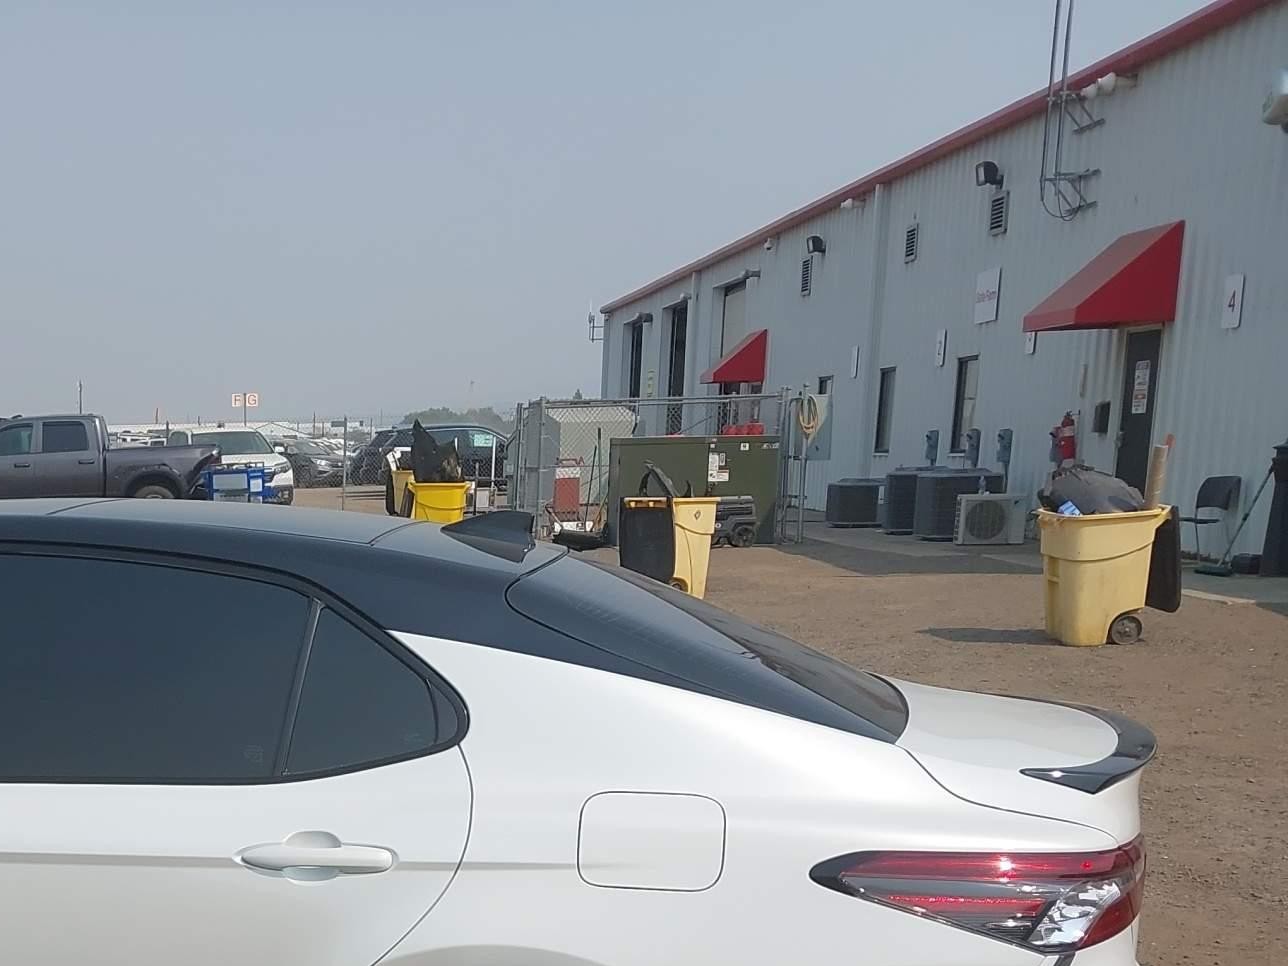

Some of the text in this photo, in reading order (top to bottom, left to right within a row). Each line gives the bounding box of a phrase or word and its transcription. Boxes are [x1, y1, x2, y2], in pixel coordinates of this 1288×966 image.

[1228, 290, 1236, 312] 4
[234, 395, 241, 406] F
[248, 394, 257, 406] G
